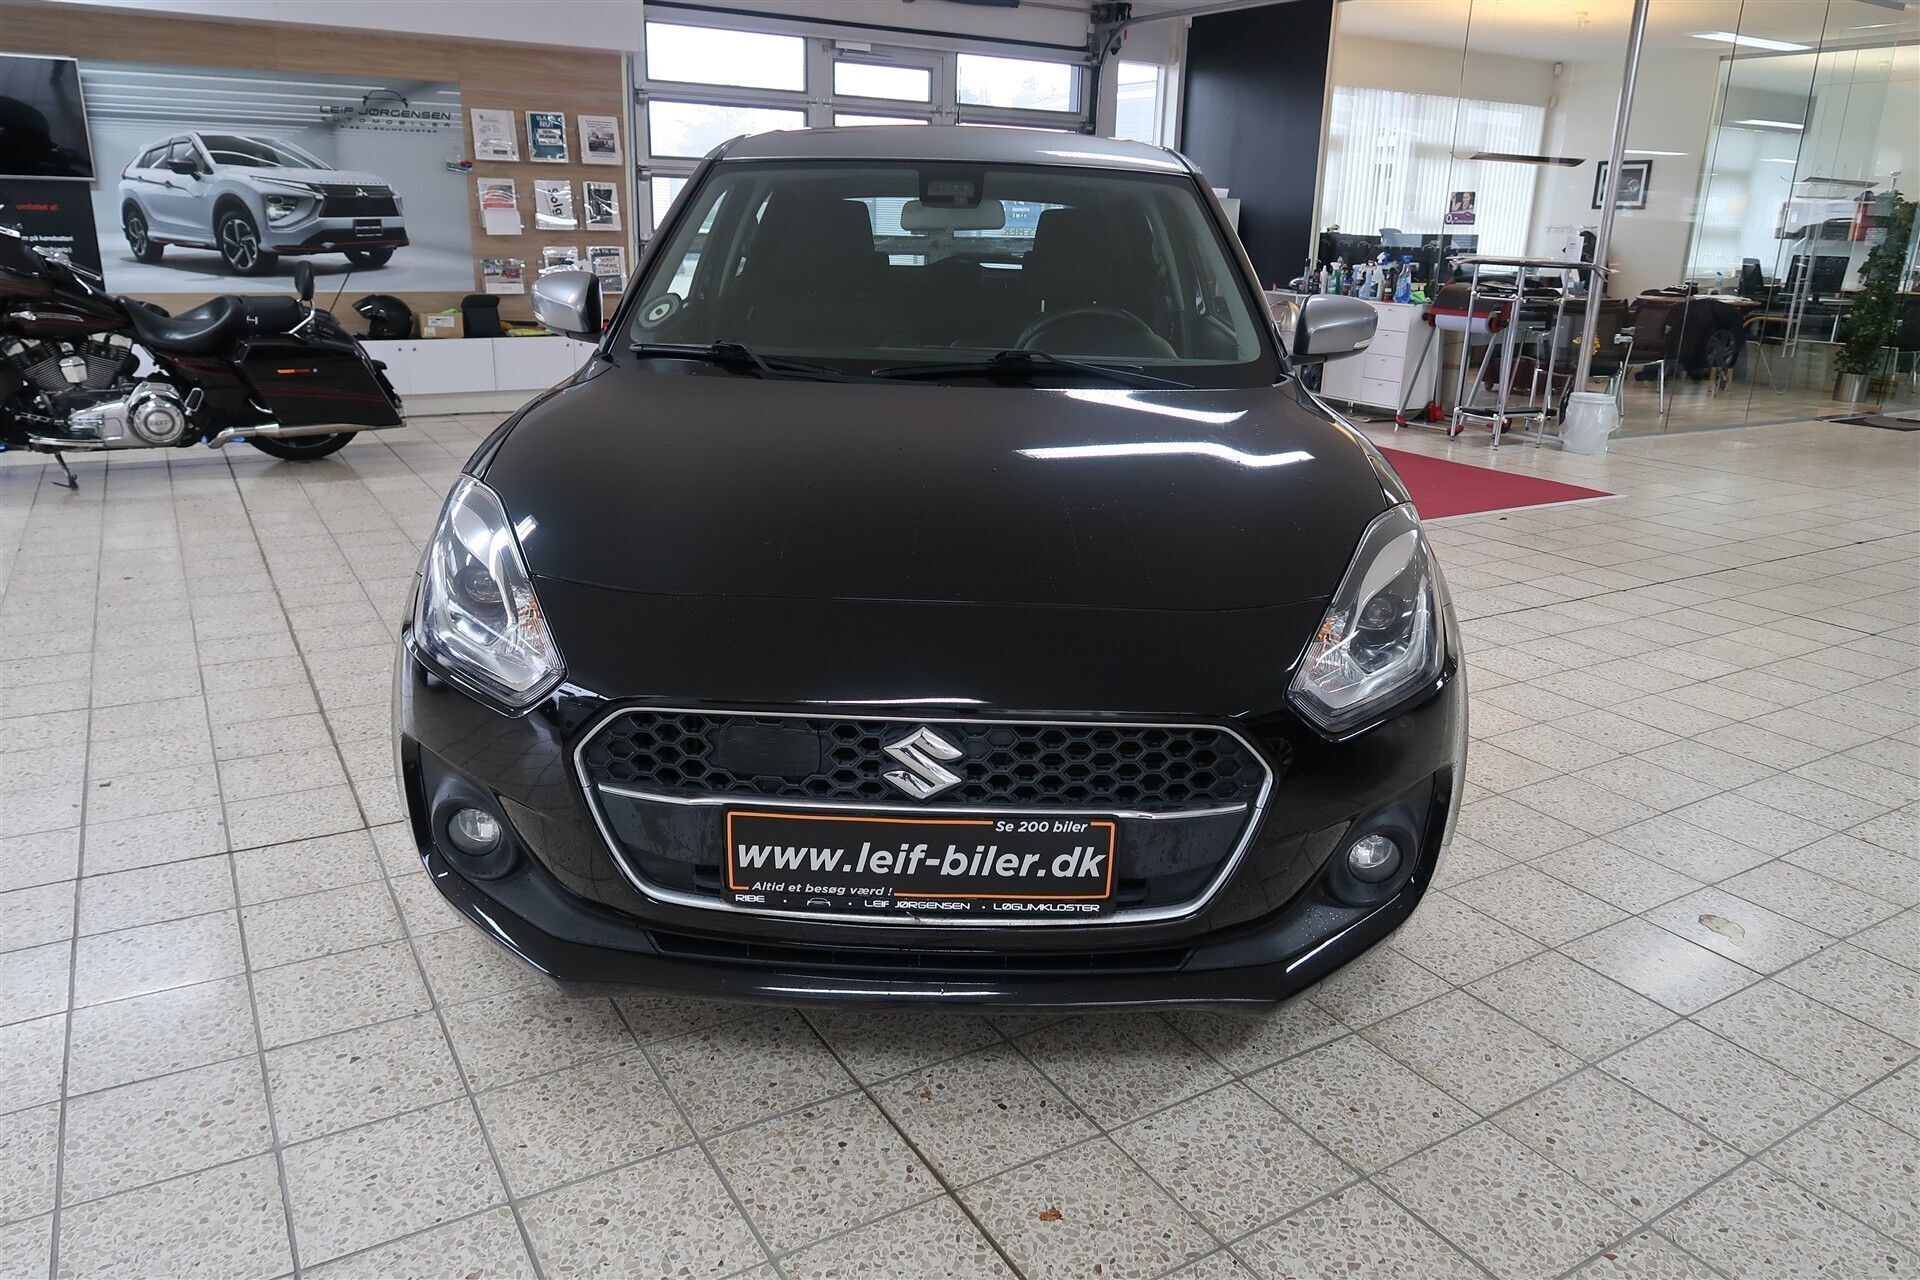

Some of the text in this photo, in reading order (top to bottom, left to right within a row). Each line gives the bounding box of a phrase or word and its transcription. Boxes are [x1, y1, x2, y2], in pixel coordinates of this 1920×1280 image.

[319, 105, 451, 121] LEIF JØRGENSEN
[995, 820, 1088, 834] Se 200 biler
[737, 842, 1107, 878] www.leif-biler.dk
[751, 881, 785, 892] Altid
[788, 883, 802, 892] et
[805, 883, 846, 896] besøg
[848, 886, 886, 896] værd
[735, 894, 765, 904] RIBE
[864, 900, 970, 911] LEIF JØRGENSEN
[992, 903, 1100, 913] LØGUMKLOSTER
